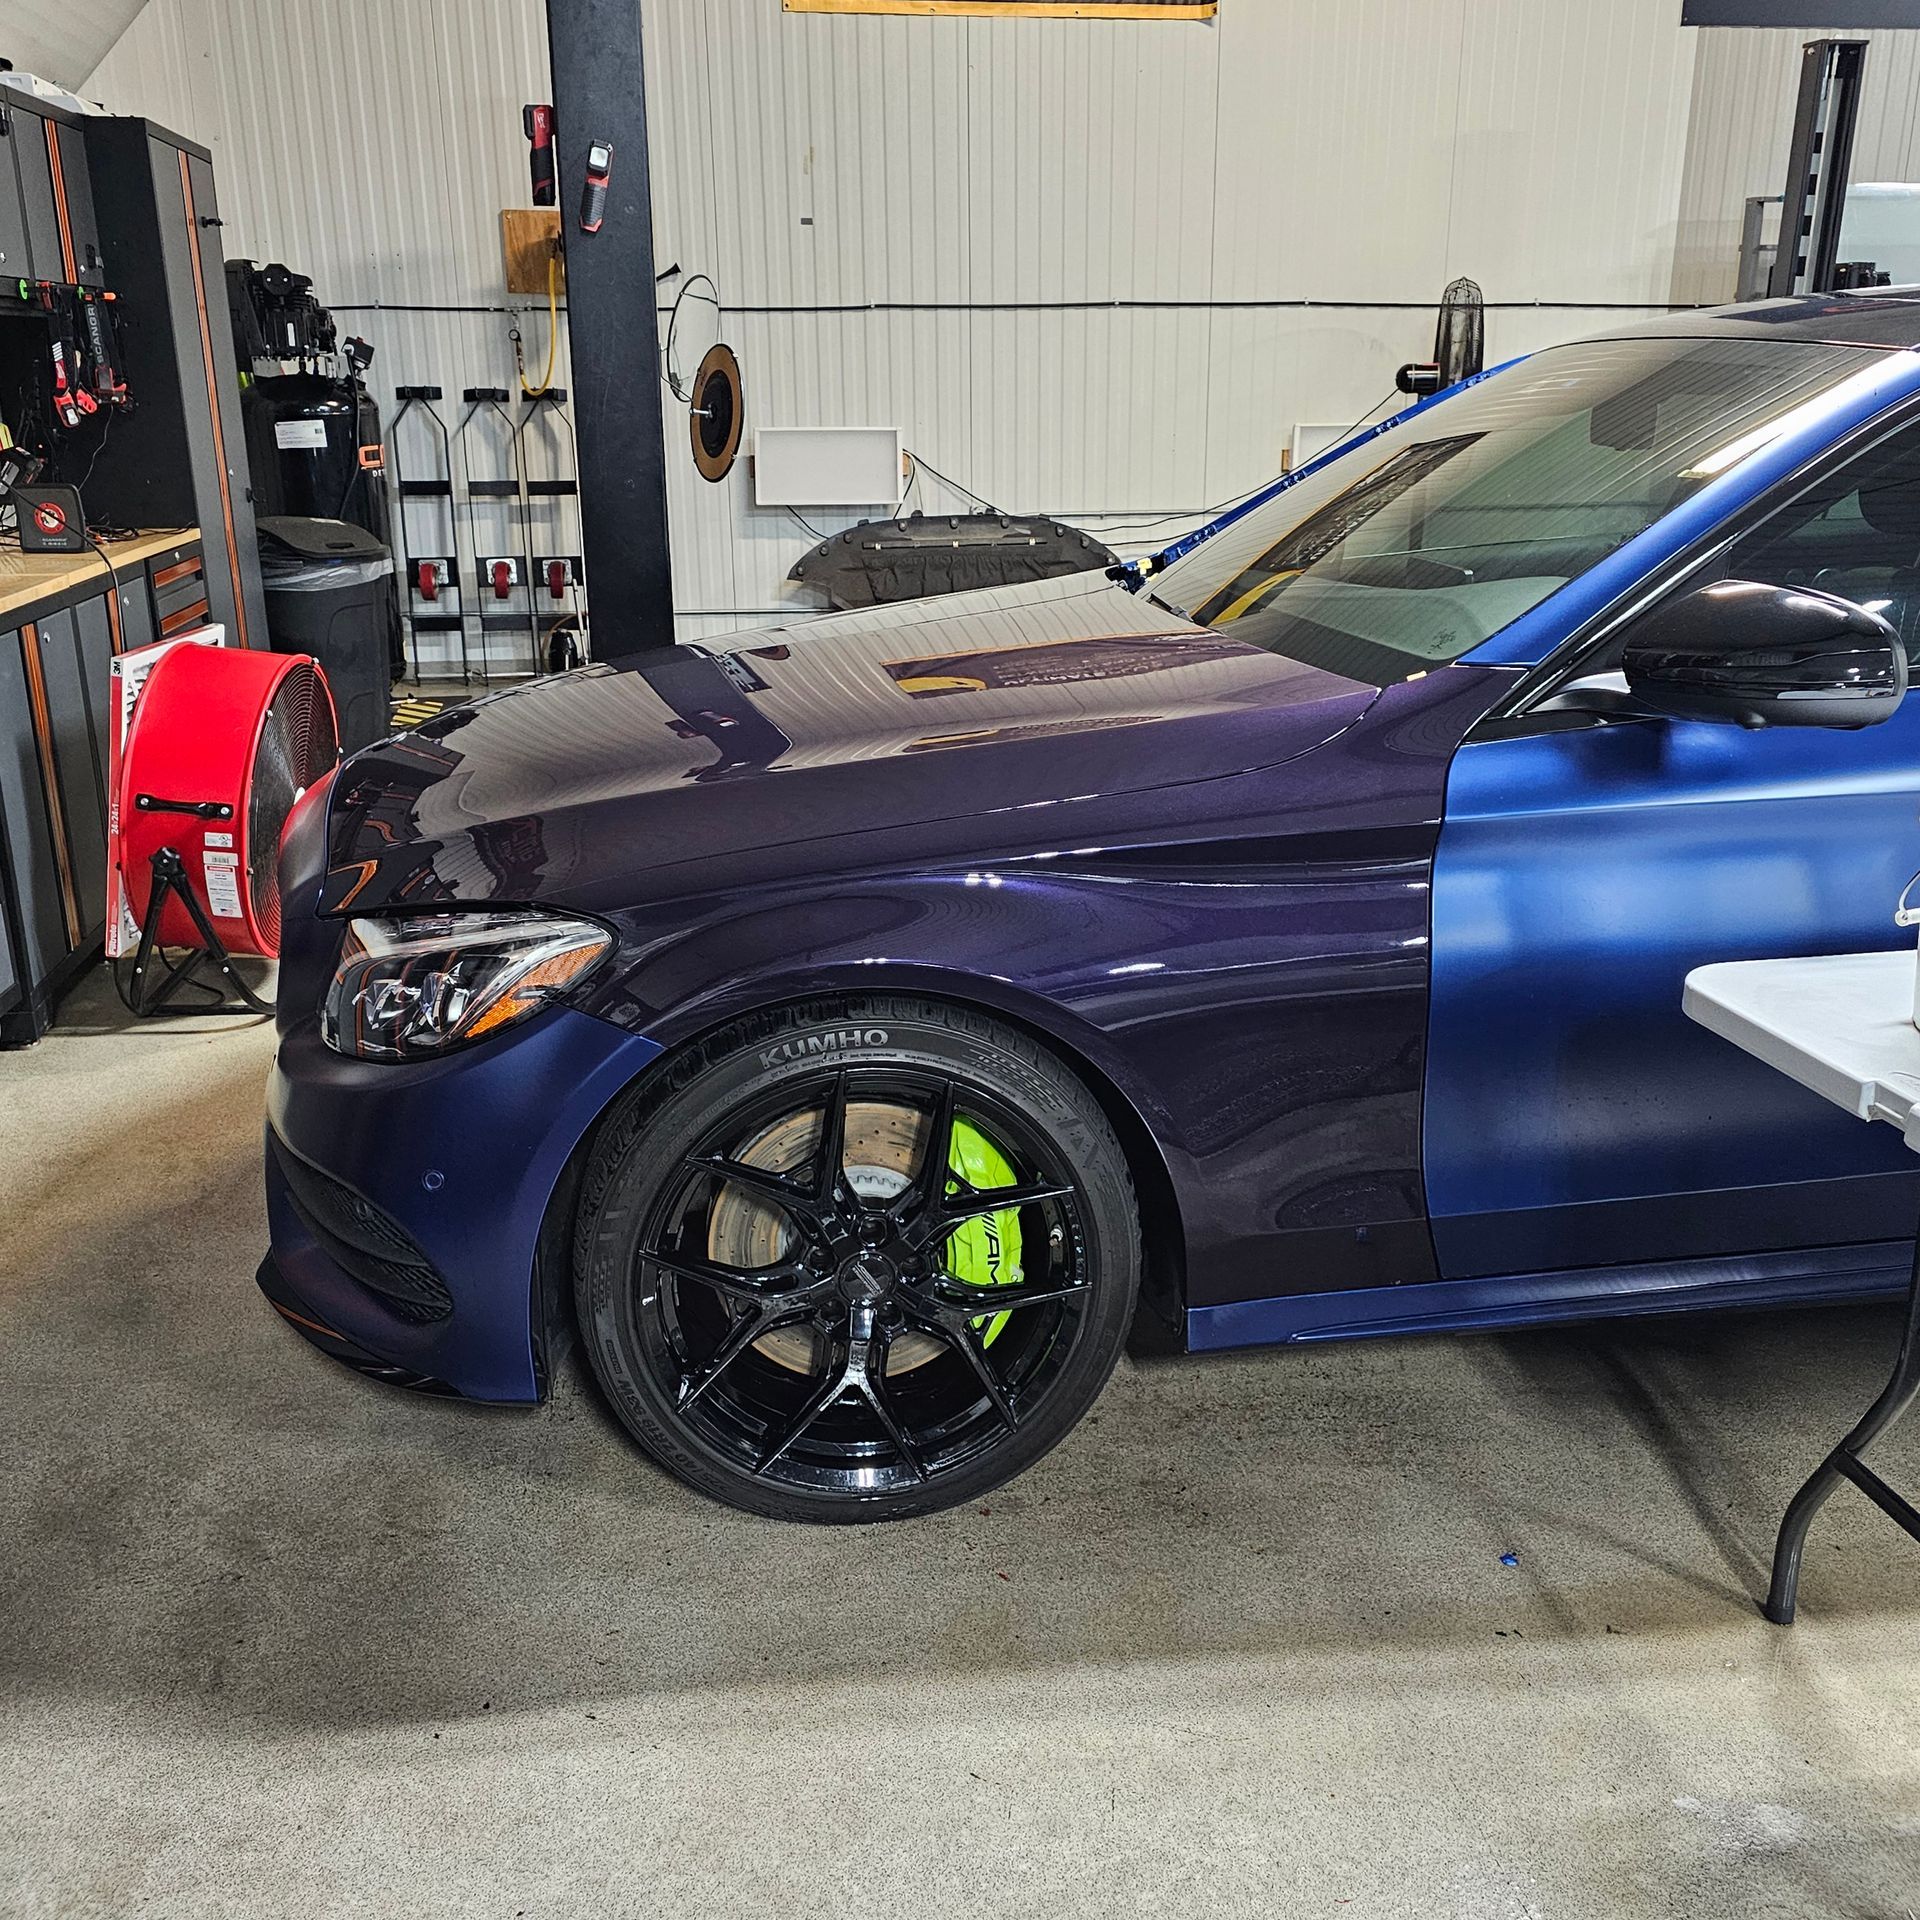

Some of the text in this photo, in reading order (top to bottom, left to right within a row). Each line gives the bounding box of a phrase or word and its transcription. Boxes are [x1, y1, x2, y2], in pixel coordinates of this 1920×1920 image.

[87, 304, 104, 364] SCANGRI
[113, 661, 121, 675] 3M
[758, 1029, 889, 1070] KUMHO
[984, 1231, 1000, 1285] AM
